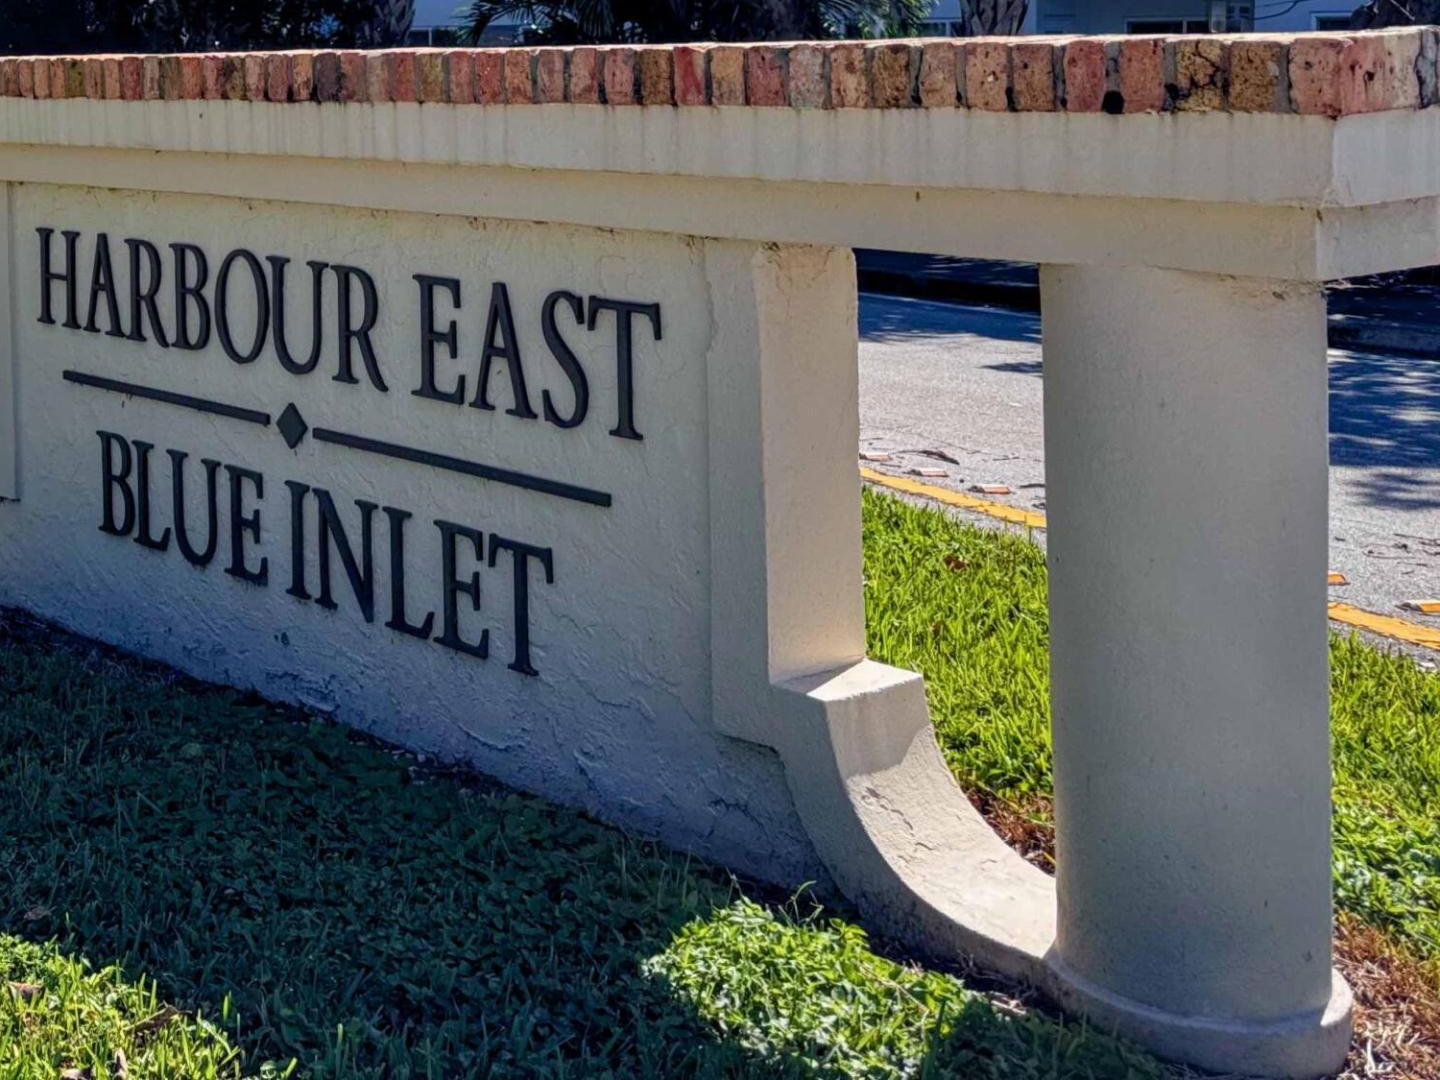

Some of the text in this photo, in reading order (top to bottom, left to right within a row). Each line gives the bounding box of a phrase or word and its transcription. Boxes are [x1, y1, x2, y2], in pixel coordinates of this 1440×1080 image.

[35, 227, 663, 440] HARBOUR EAST
[96, 430, 553, 677] BLUE INLET
